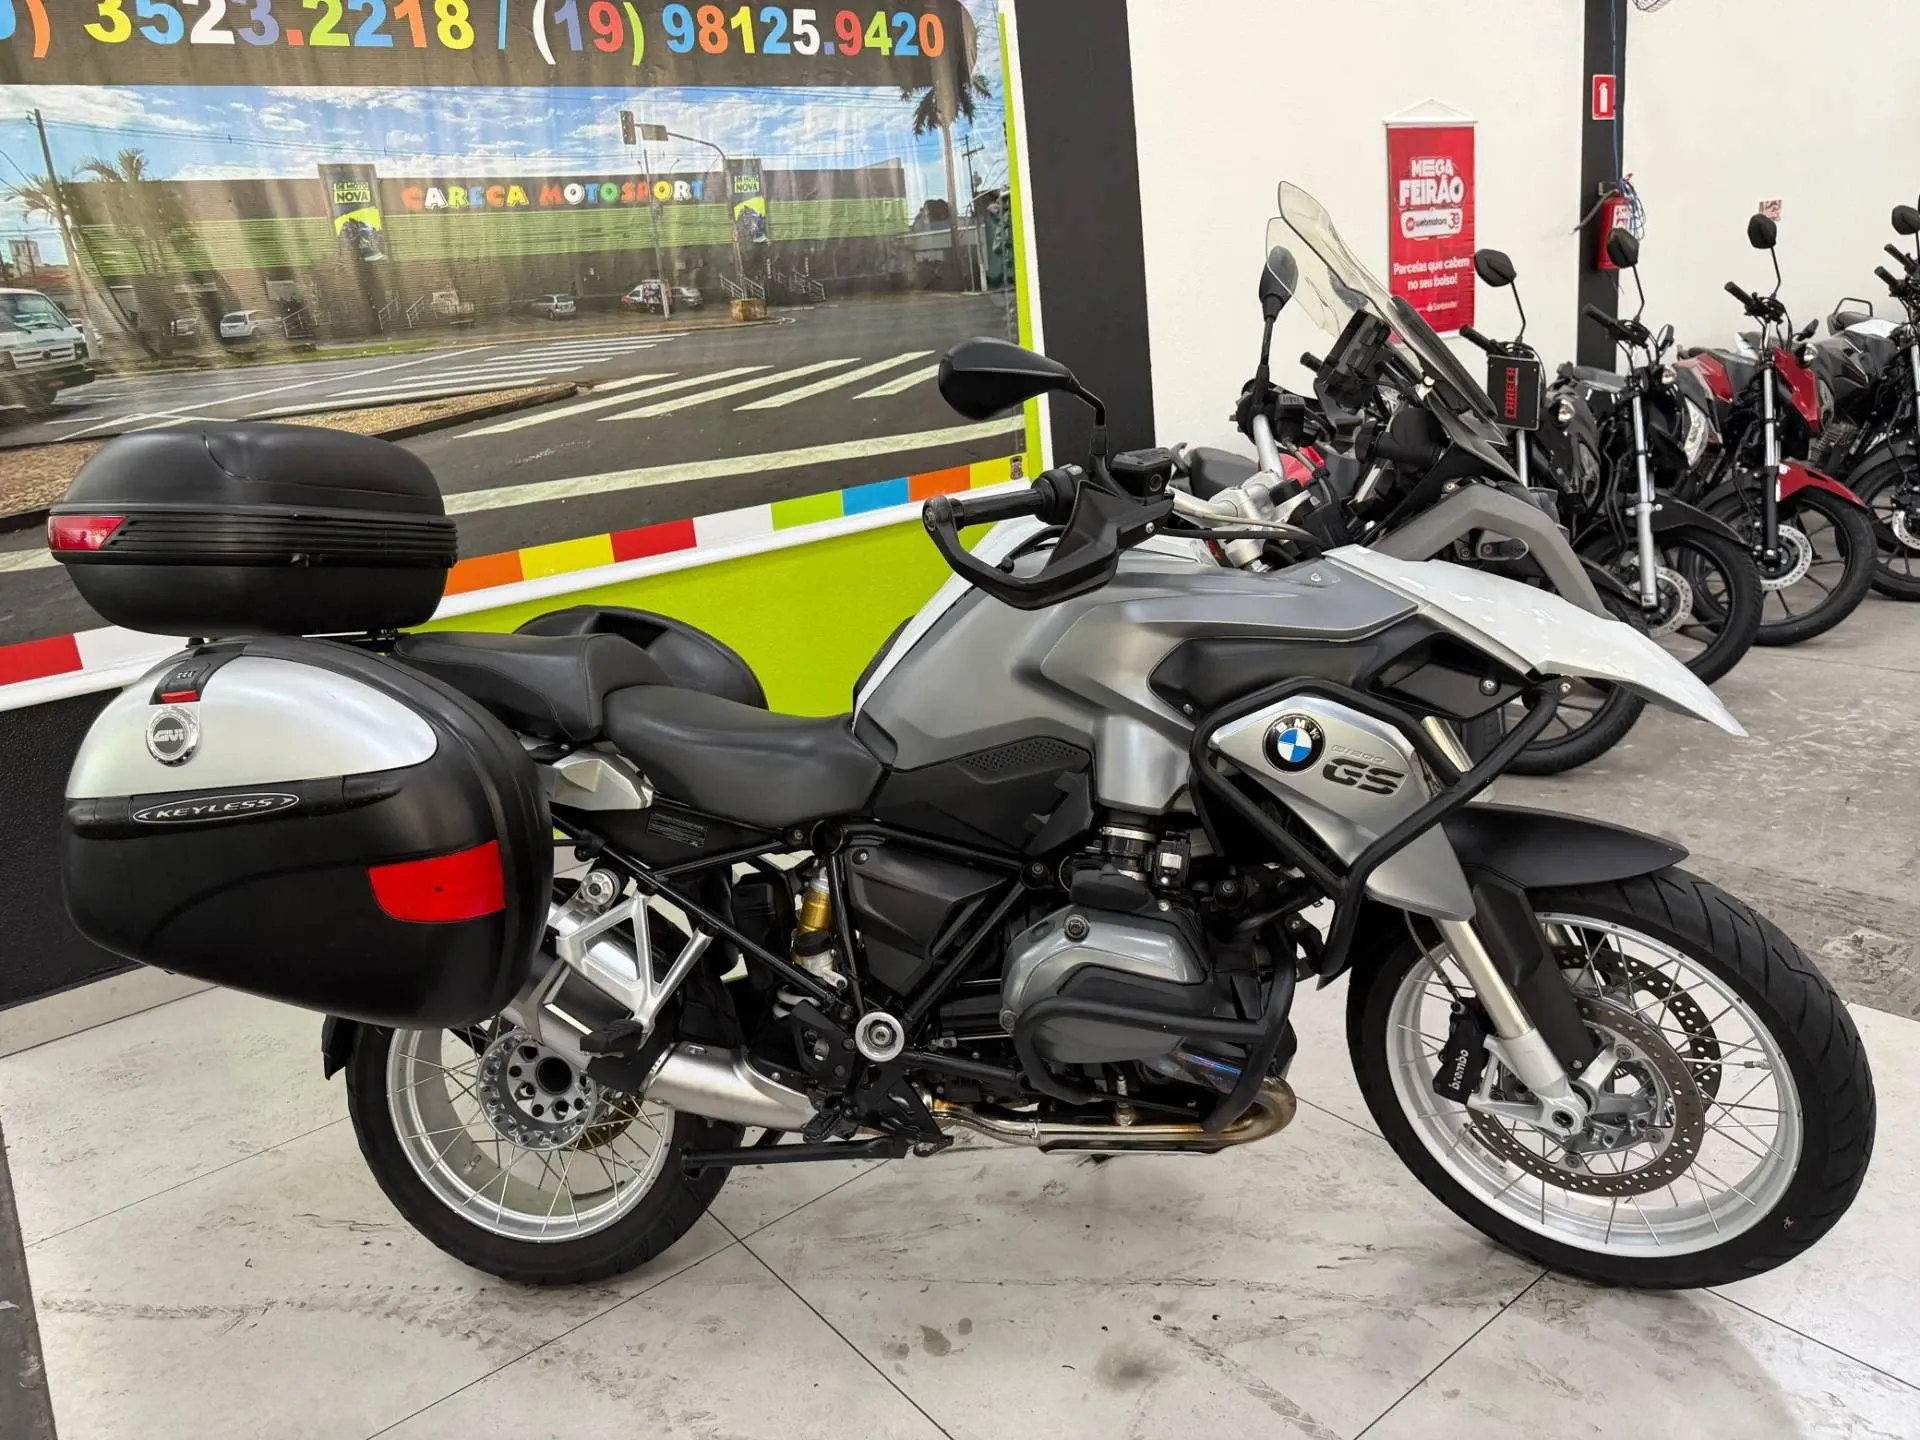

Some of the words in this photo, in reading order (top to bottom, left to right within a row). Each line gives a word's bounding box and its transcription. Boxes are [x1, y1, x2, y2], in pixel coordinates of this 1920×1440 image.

[84, 0, 475, 50] 3523.2218
[532, 0, 645, 65] (19)
[662, 4, 944, 57] 98125.9420
[1411, 158, 1454, 177] MEGA
[336, 191, 369, 202] NOVA
[402, 185, 530, 212] CARECA
[539, 179, 705, 206] MOTOSPORT
[736, 182, 758, 192] NOVA
[1399, 174, 1465, 206] FEIRÃO
[1393, 260, 1428, 275] Parcelas
[1428, 260, 1443, 274] que
[1444, 256, 1470, 269] cabem
[1407, 280, 1418, 291] no
[1419, 279, 1433, 289] seu
[153, 728, 185, 743] GIVI
[1322, 757, 1405, 795] GS
[156, 797, 276, 819] KEYLESS
[1448, 1049, 1470, 1091] brembo
